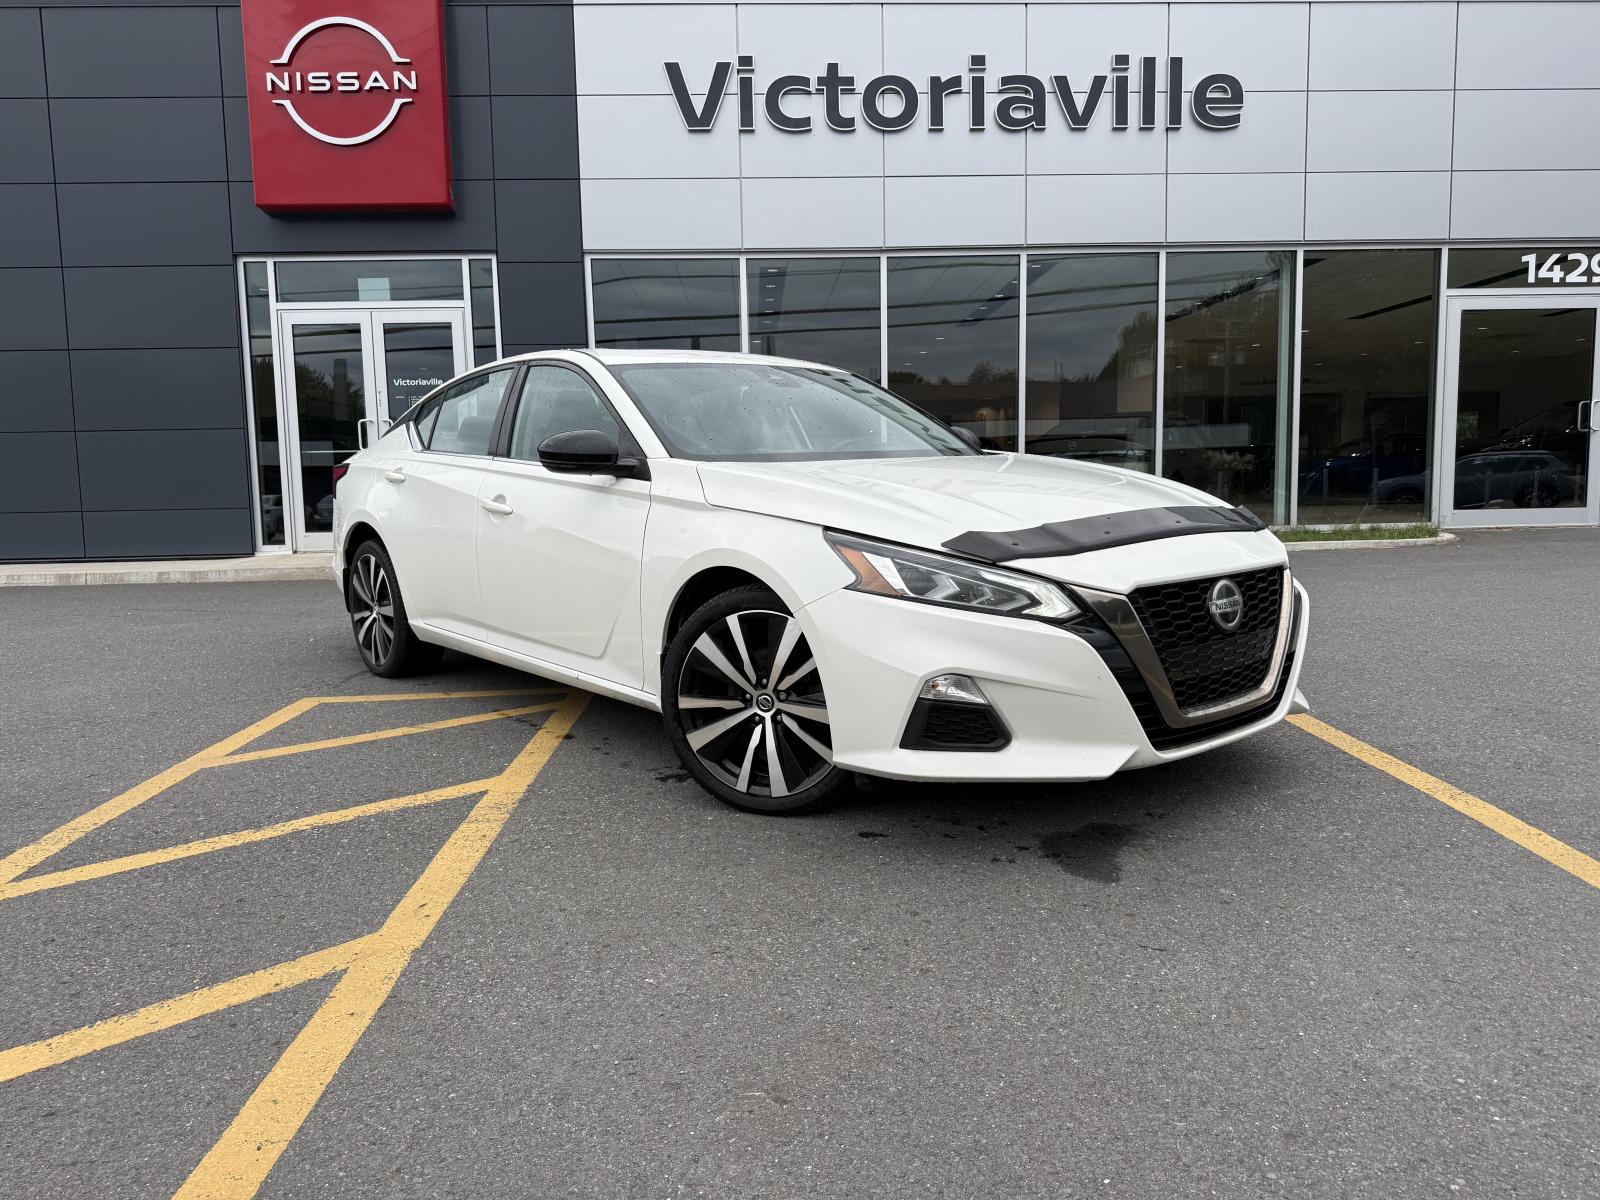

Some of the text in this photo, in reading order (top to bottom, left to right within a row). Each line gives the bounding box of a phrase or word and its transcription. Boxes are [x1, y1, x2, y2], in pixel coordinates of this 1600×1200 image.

[265, 70, 418, 92] NISSAN
[662, 54, 1245, 133] Victoriaville
[393, 377, 443, 386] Victoriaville
